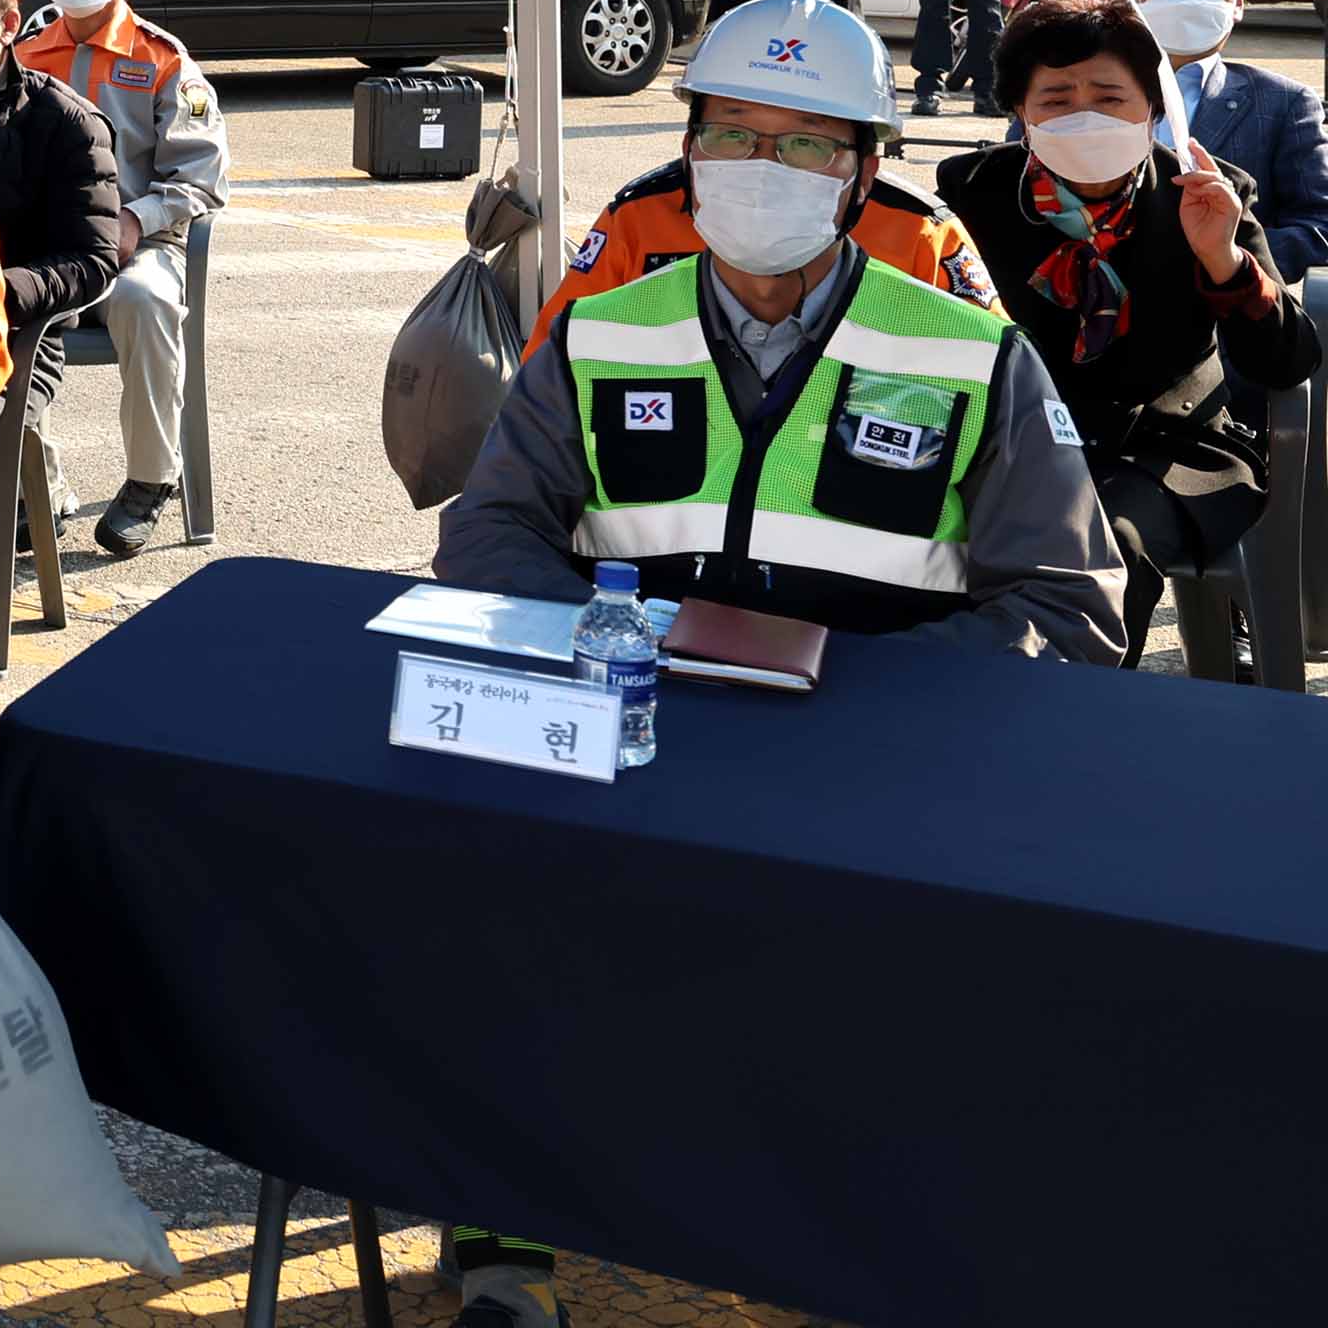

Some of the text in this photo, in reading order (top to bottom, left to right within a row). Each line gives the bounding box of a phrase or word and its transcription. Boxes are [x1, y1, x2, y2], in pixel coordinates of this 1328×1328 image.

[424, 673, 475, 696] 동국제강
[478, 685, 531, 705] 관리이사
[427, 701, 579, 764] 김 현
